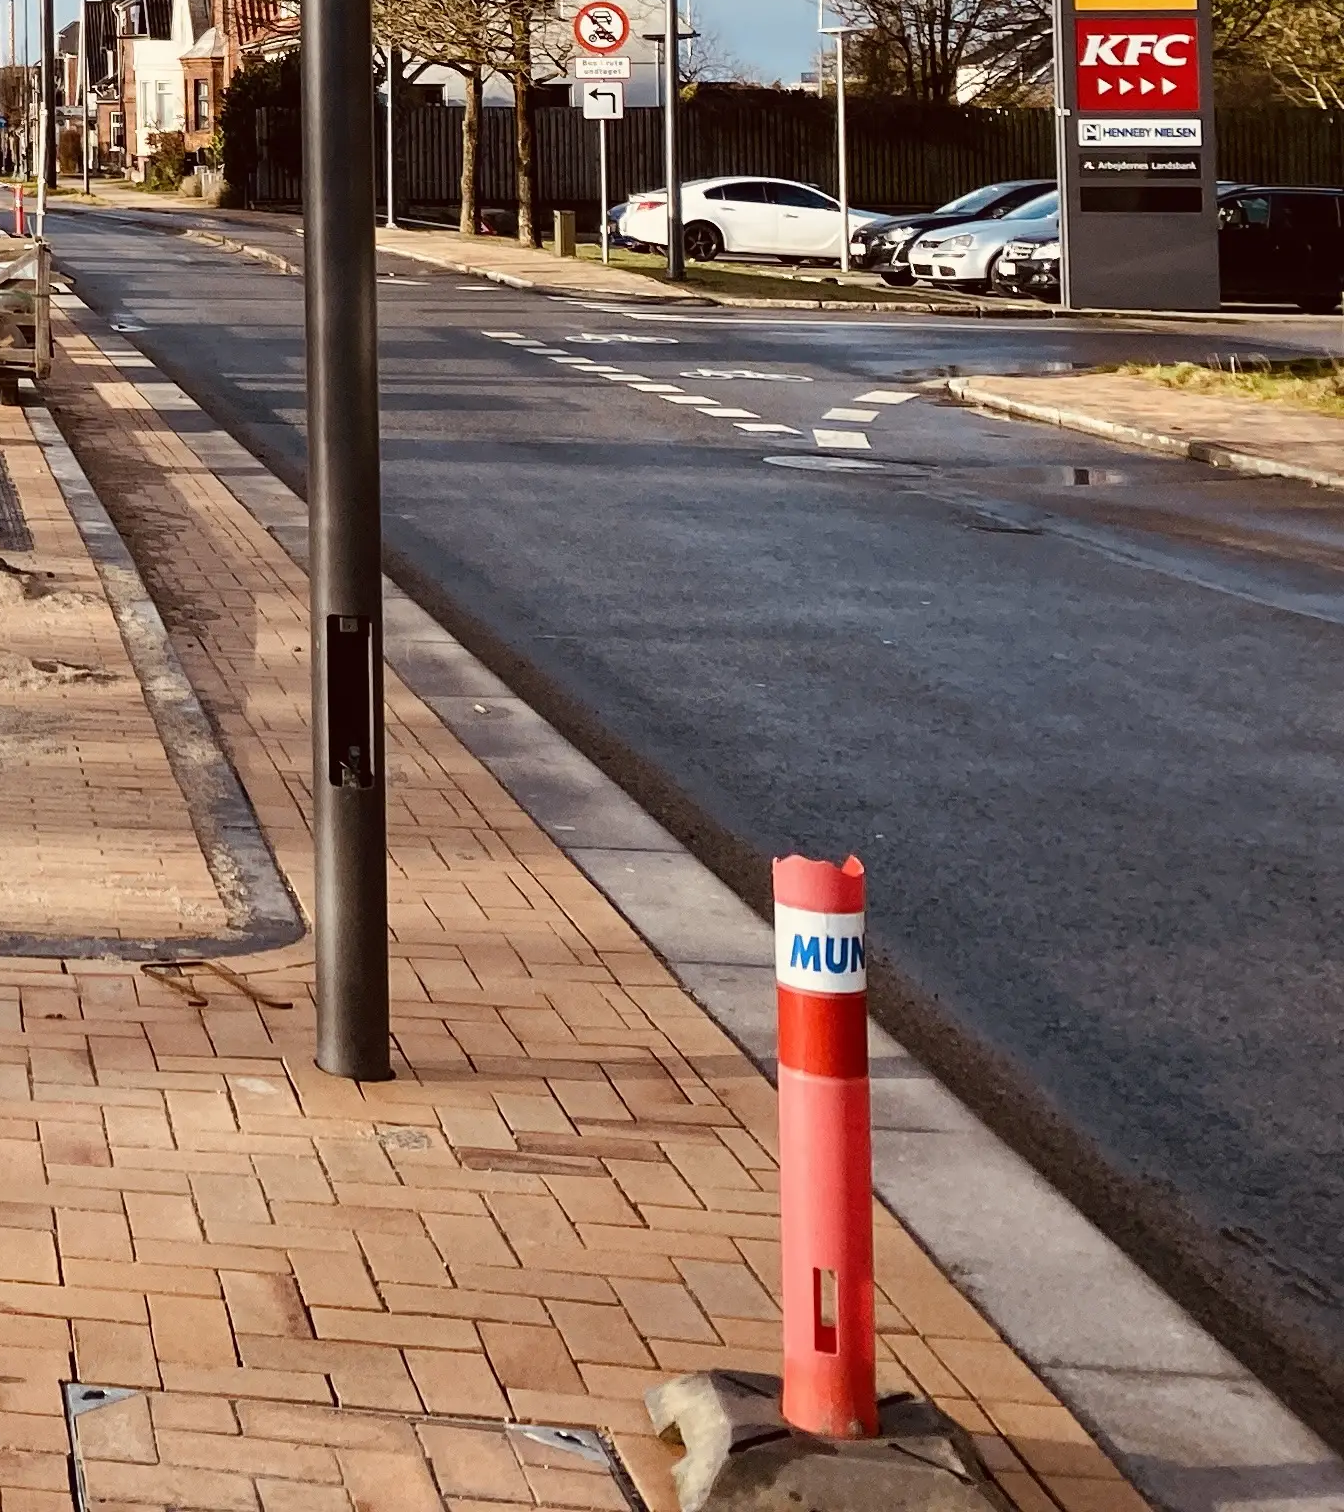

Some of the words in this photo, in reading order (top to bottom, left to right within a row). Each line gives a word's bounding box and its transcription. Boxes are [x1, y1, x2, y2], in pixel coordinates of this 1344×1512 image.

[1079, 34, 1190, 66] KFC
[1103, 128, 1152, 138] HENNEBY
[1154, 128, 1197, 138] NIELSEN
[1098, 161, 1149, 172] Arbejdernes
[1151, 161, 1197, 170] Landsbank
